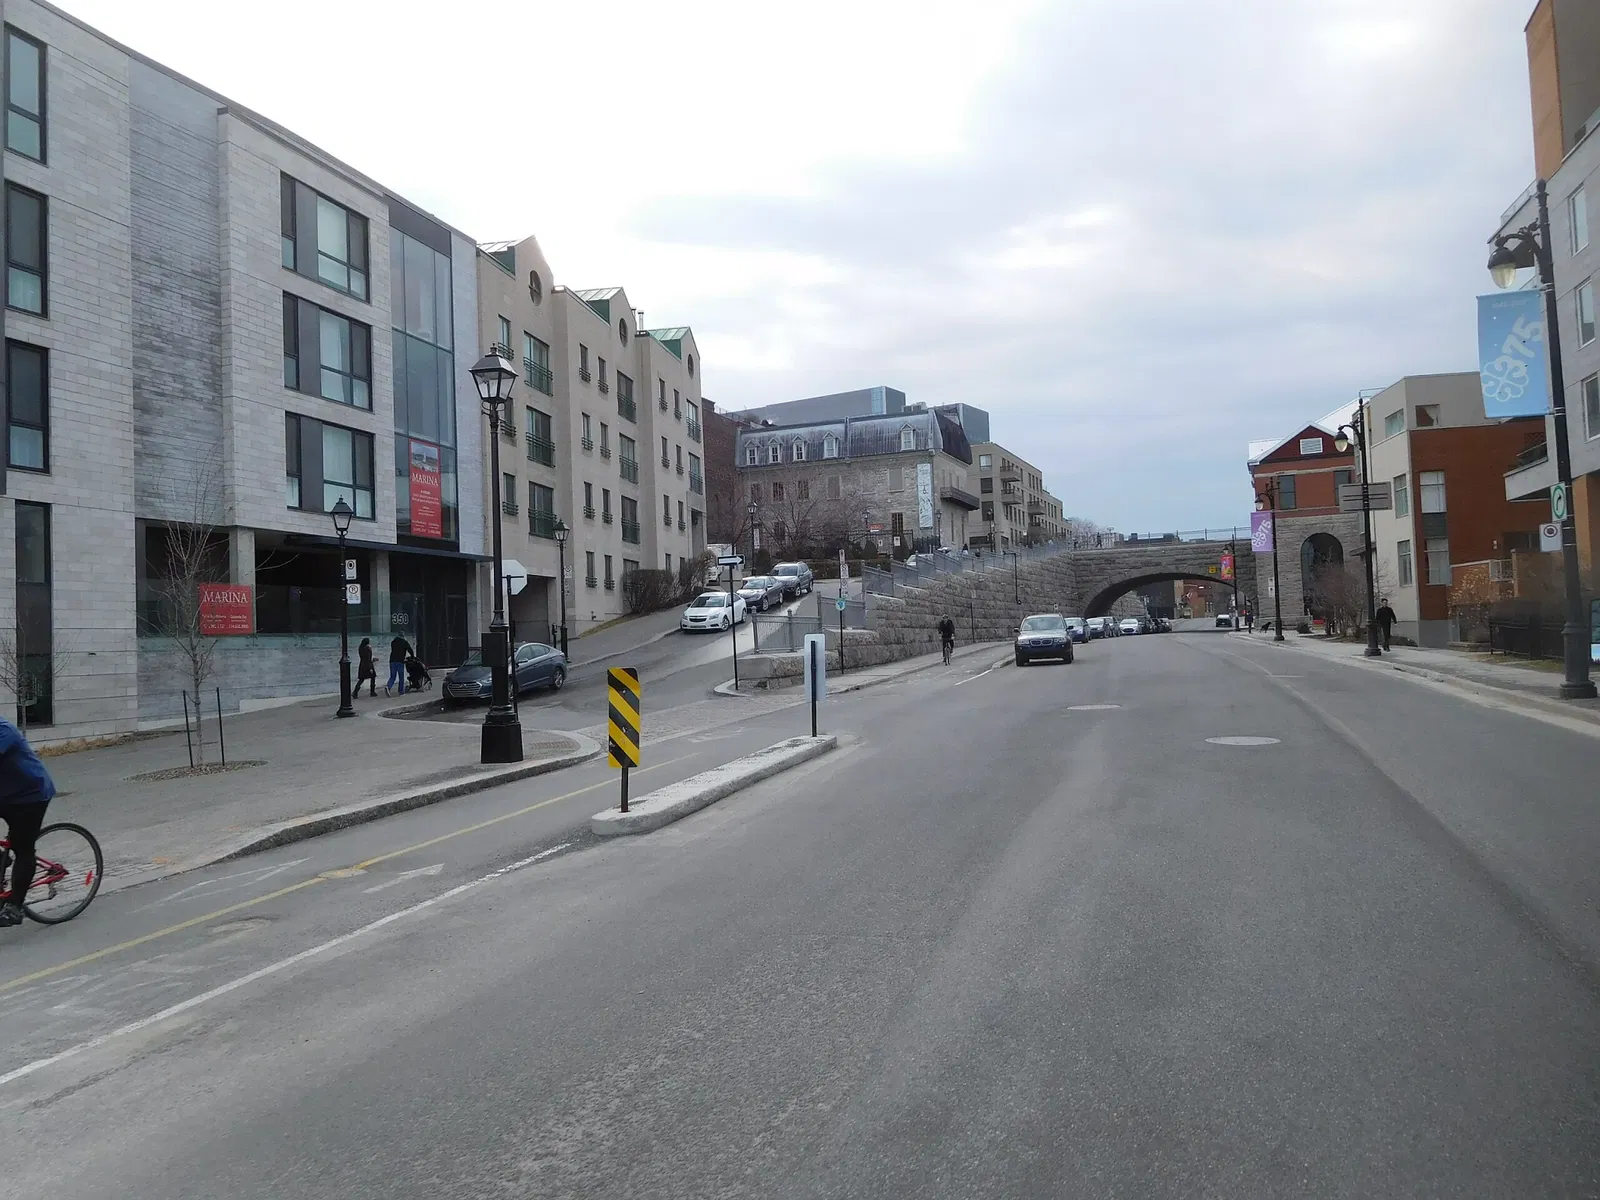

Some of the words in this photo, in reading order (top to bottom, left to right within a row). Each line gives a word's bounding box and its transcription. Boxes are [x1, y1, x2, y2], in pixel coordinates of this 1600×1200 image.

[411, 472, 439, 488] MARINA
[203, 590, 249, 604] MARINA
[391, 612, 409, 625] 350
